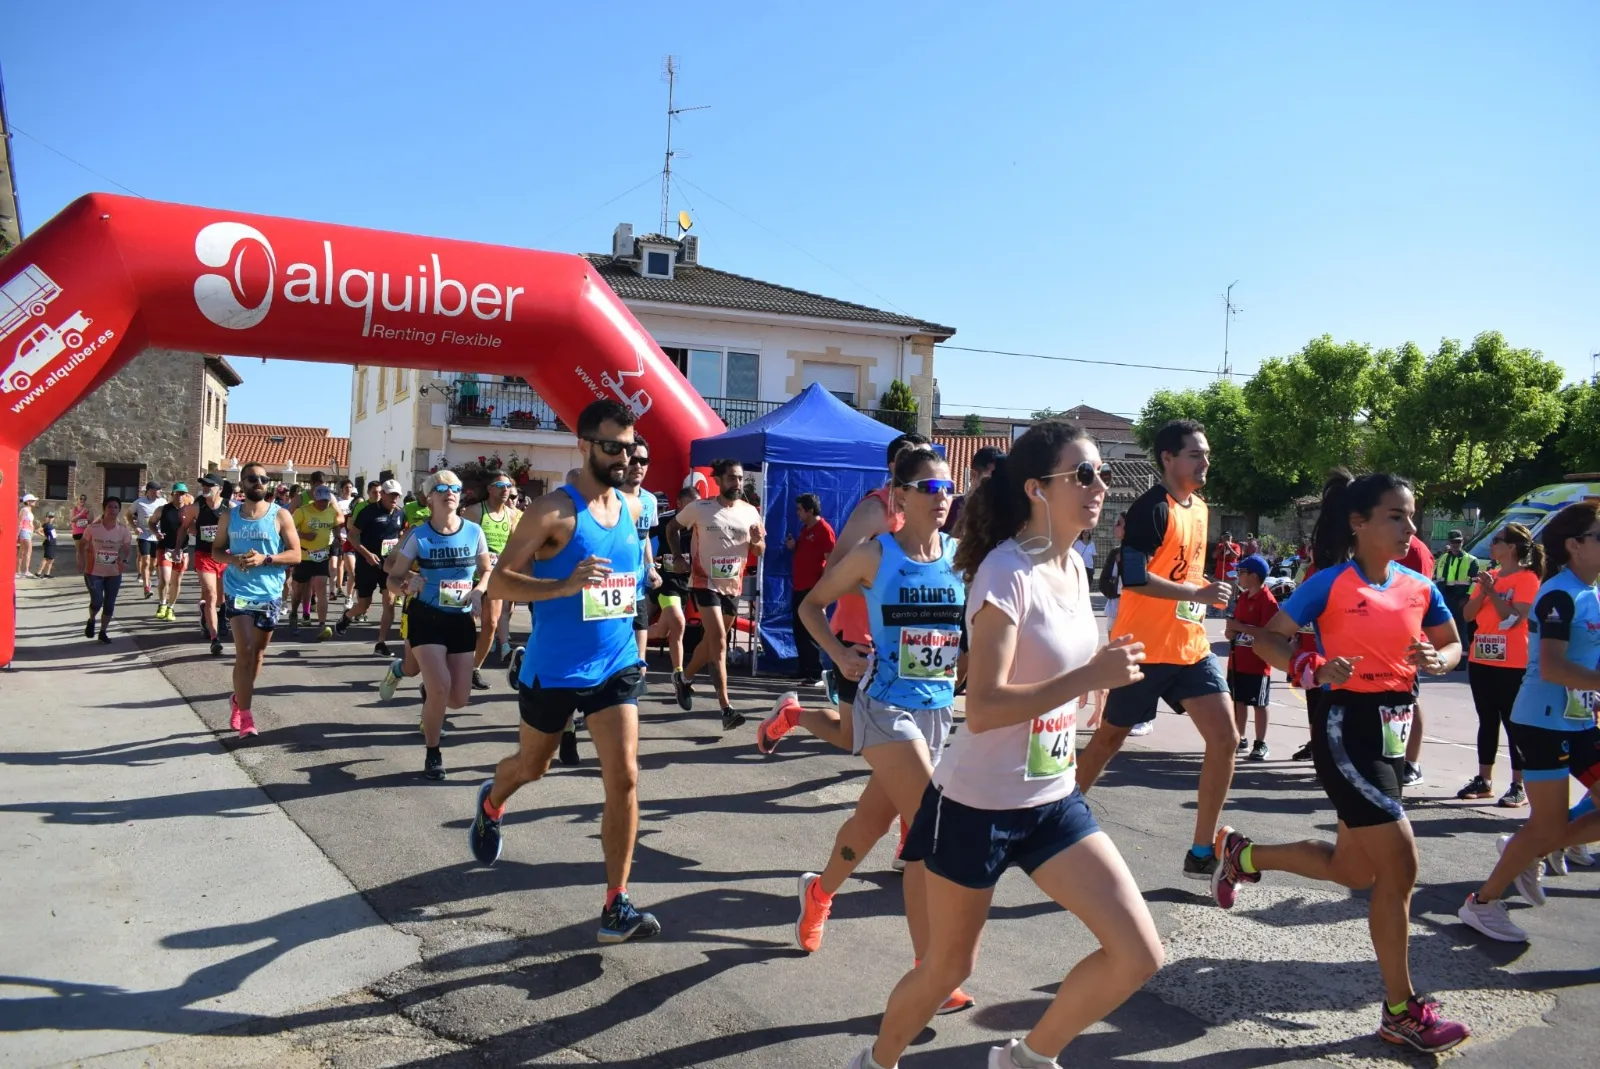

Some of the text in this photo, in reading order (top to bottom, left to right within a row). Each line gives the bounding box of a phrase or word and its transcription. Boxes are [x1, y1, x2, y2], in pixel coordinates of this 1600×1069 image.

[283, 240, 525, 337] alquiber
[372, 324, 502, 349] Renting Flexible
[10, 328, 115, 414] www.alquiber.es
[430, 544, 471, 559] naturé
[721, 564, 733, 573] 49
[456, 590, 462, 600] 7
[601, 589, 621, 607] 18
[899, 584, 957, 604] naturé
[902, 630, 959, 647] bedunia
[920, 647, 942, 667] 36
[1479, 643, 1499, 654] 185
[1051, 732, 1069, 760] 48
